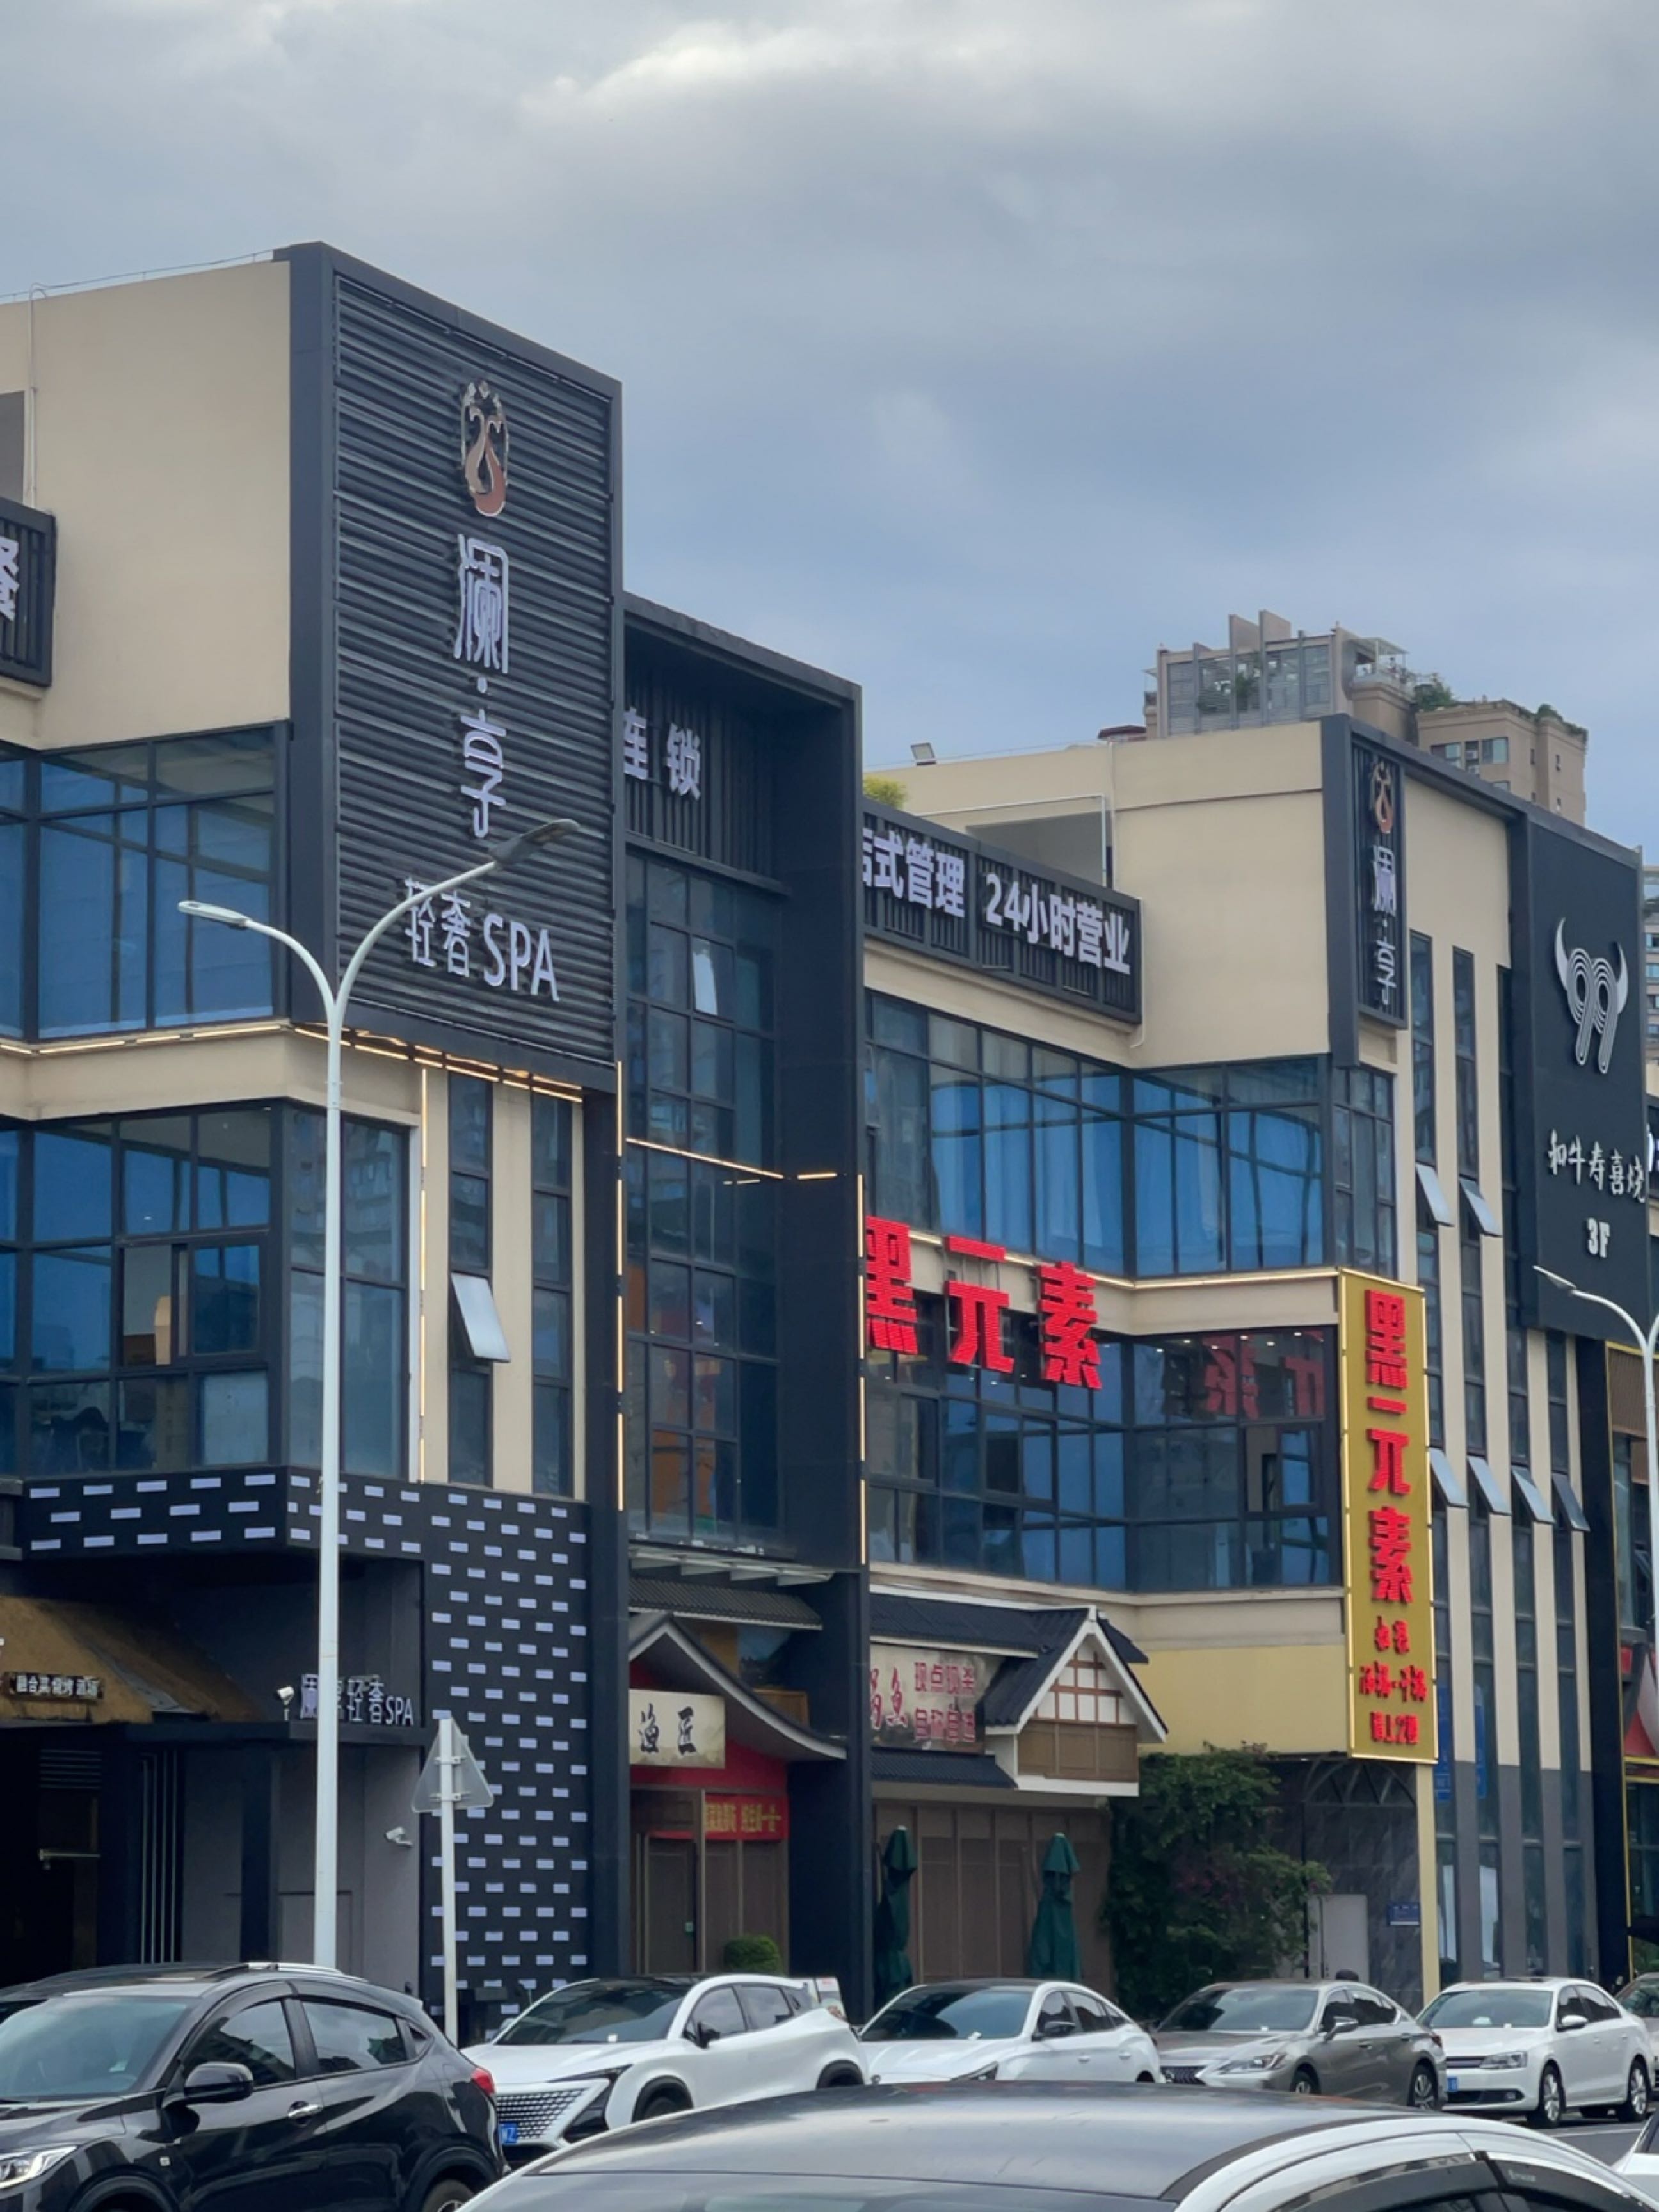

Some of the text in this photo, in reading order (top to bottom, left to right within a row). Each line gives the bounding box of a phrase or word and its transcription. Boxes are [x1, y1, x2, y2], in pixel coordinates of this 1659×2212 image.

[986, 874, 1132, 975] 24小时营业
[1587, 1217, 1610, 1258] 3F
[1364, 1289, 1413, 1603] 黑元素
